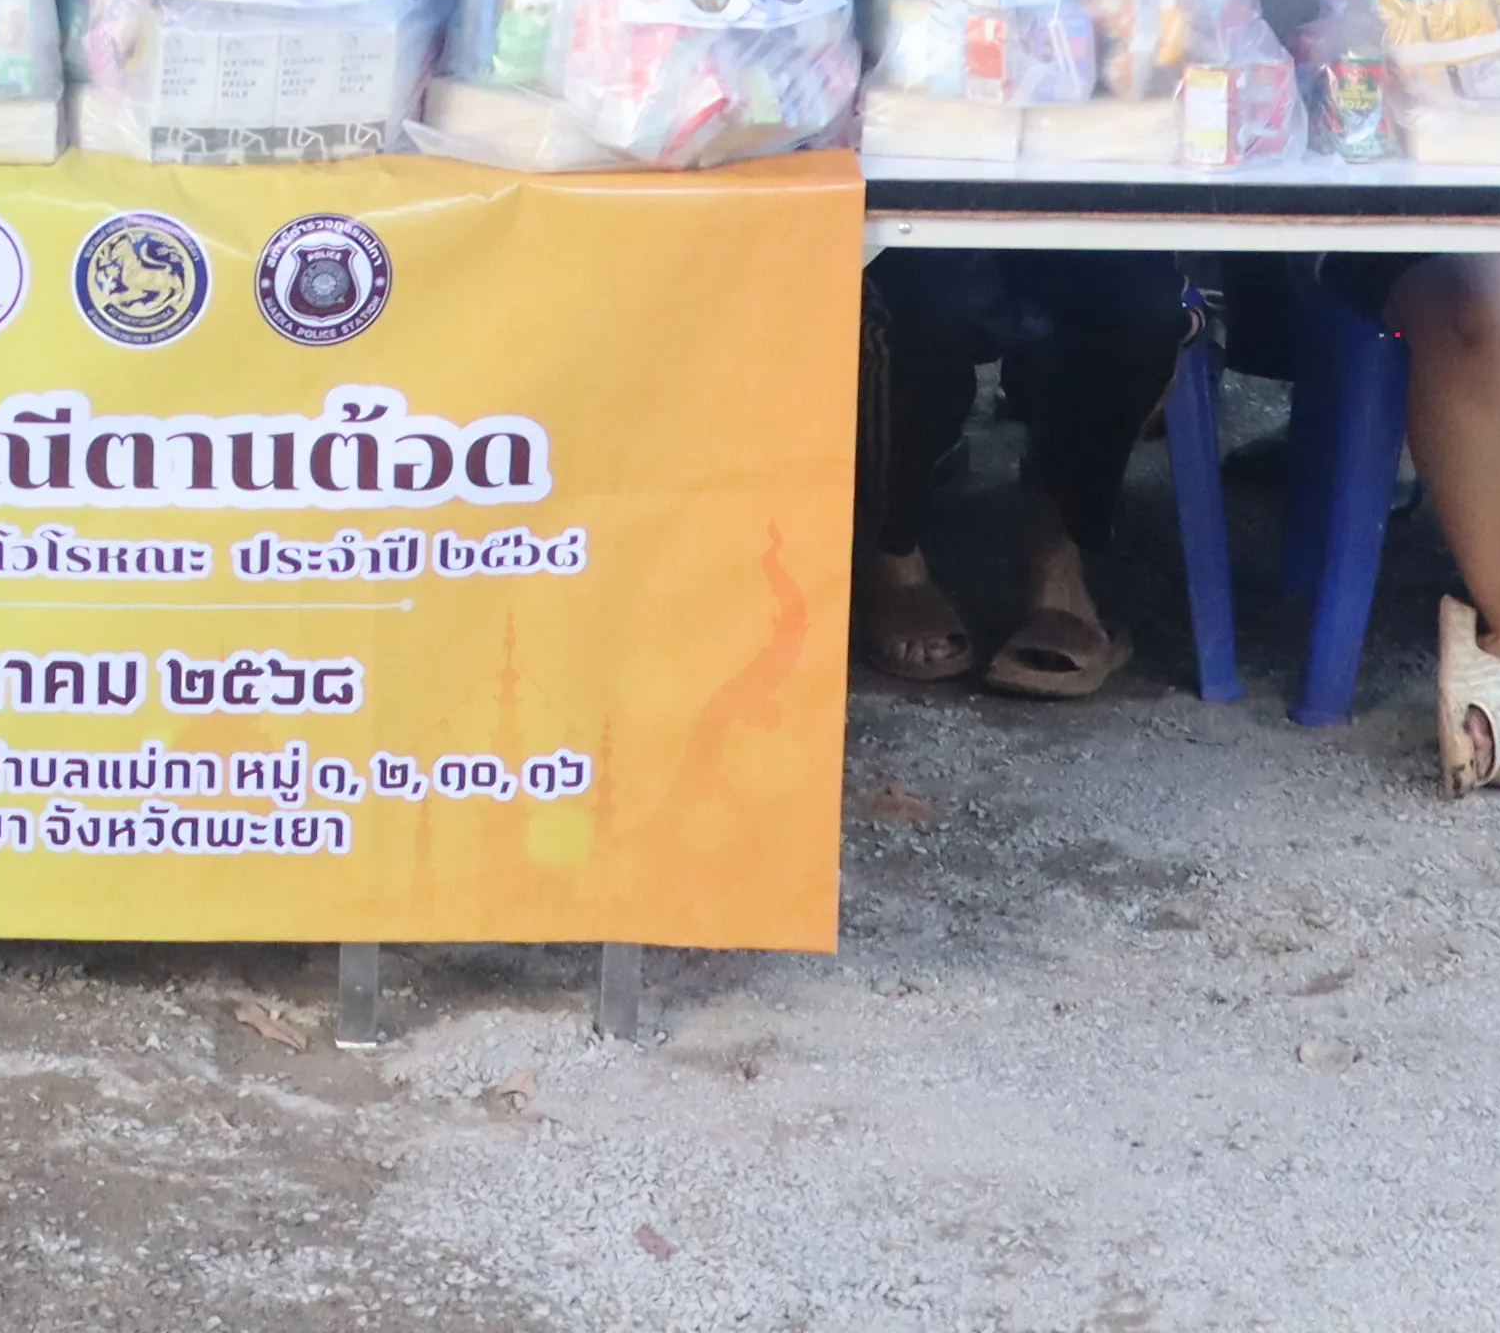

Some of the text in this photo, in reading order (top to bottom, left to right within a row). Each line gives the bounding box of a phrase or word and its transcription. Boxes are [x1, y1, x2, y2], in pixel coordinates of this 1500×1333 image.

[238, 534, 418, 575] ประจำปี
[440, 533, 582, 570] ๒๕๖๘
[166, 657, 355, 707] ๒๕๖๘
[236, 746, 301, 803] หมู่
[318, 764, 360, 796] ๑,
[378, 757, 423, 794] ๒,
[47, 805, 345, 849] จังหวัดพะเยา
